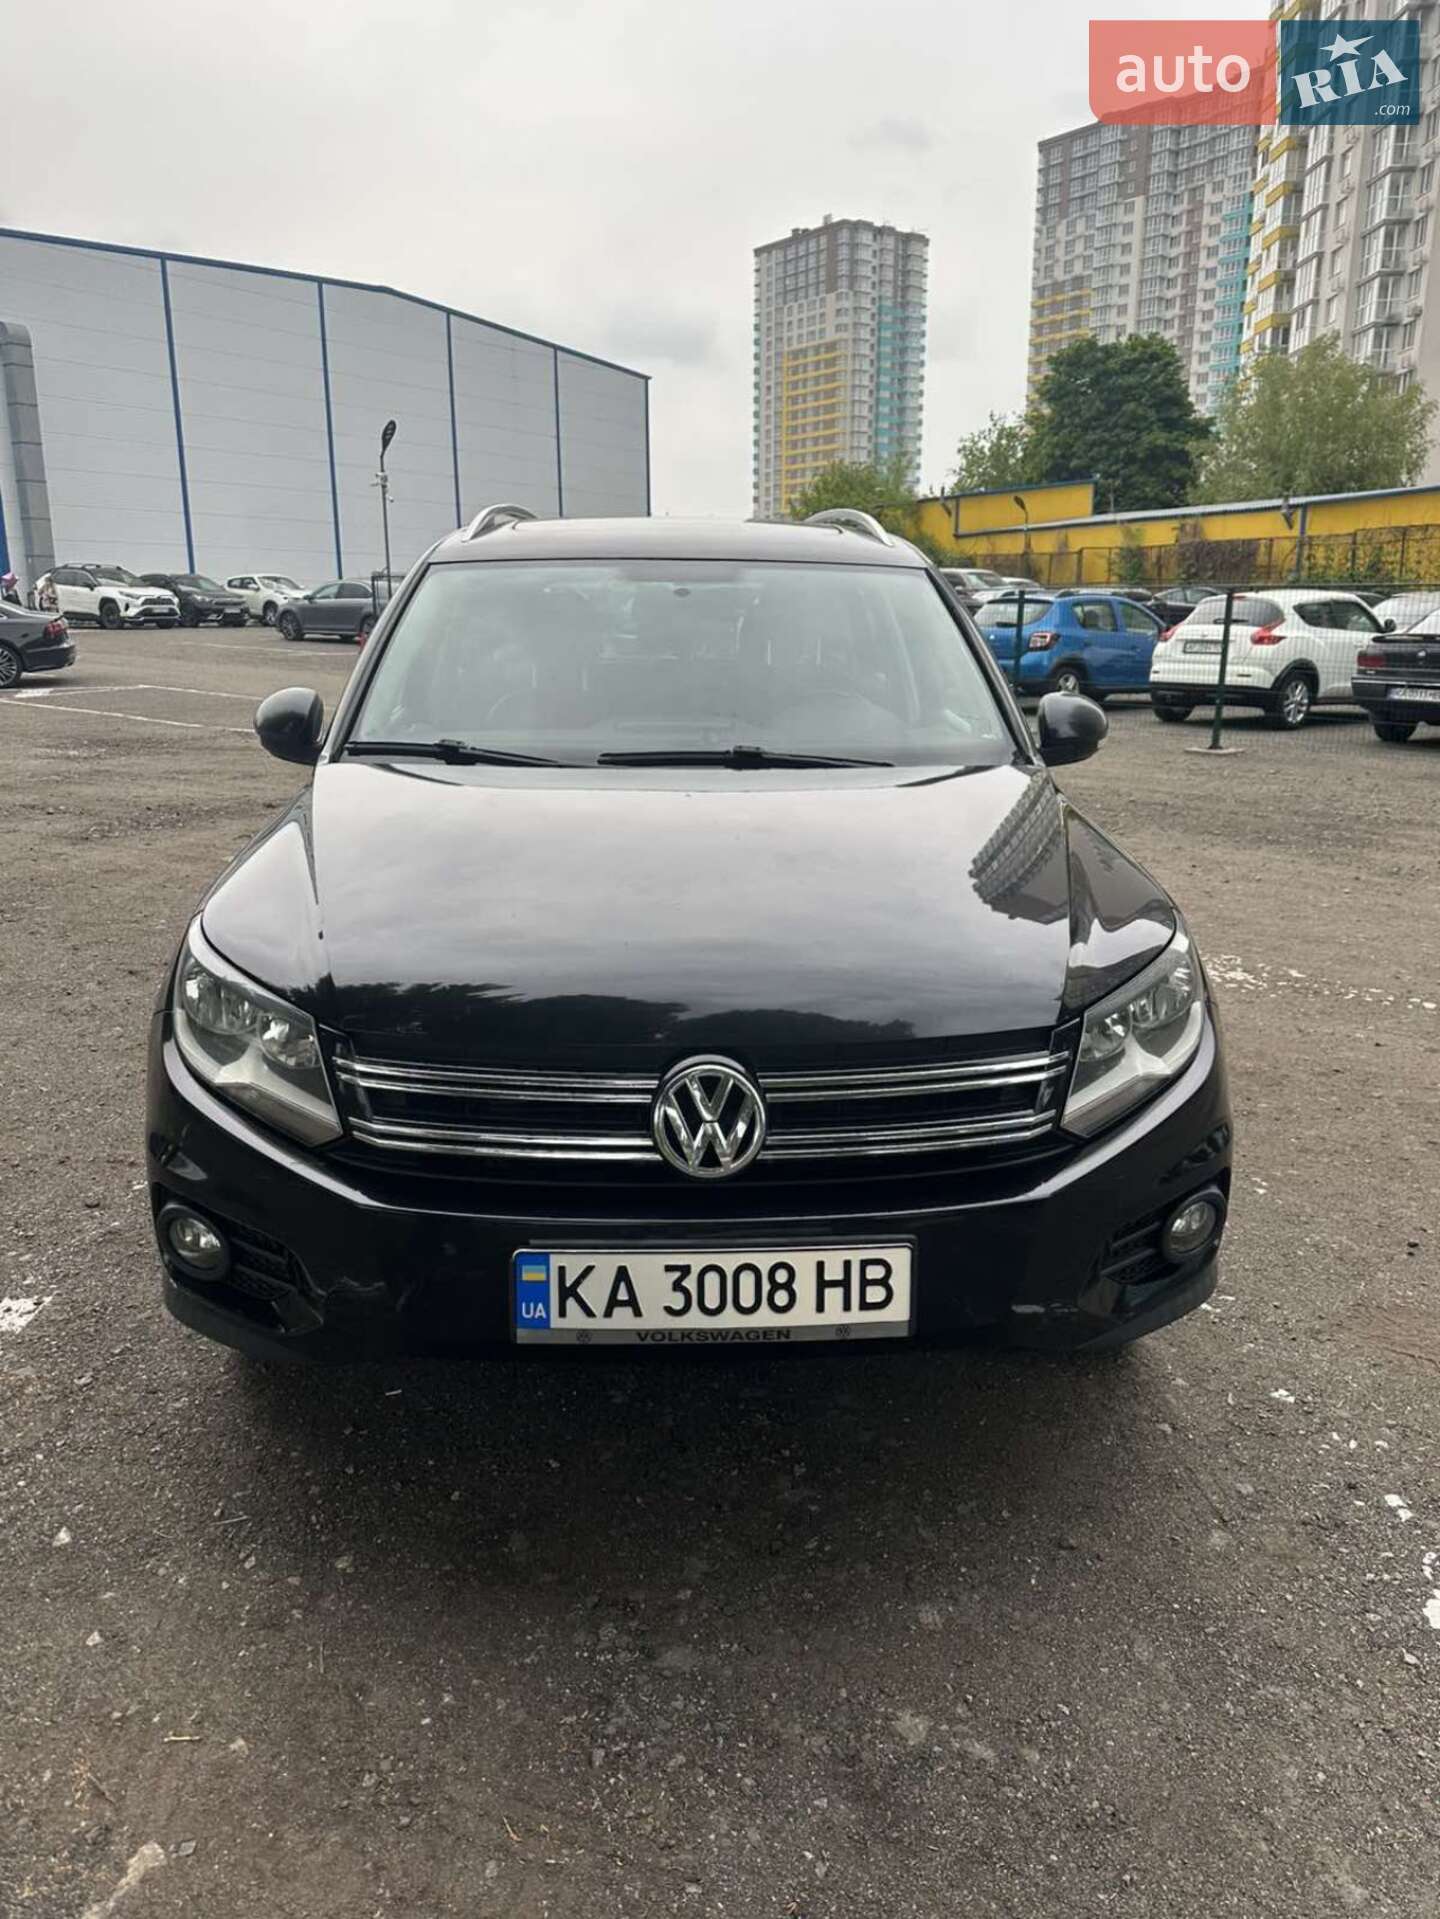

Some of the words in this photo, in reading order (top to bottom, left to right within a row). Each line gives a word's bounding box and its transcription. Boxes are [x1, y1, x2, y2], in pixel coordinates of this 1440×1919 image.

[557, 1264, 643, 1319] KA
[663, 1262, 798, 1317] 3008
[815, 1258, 894, 1313] HB
[521, 1303, 547, 1319] UA
[635, 1329, 792, 1343] VOLKSWAGEN
